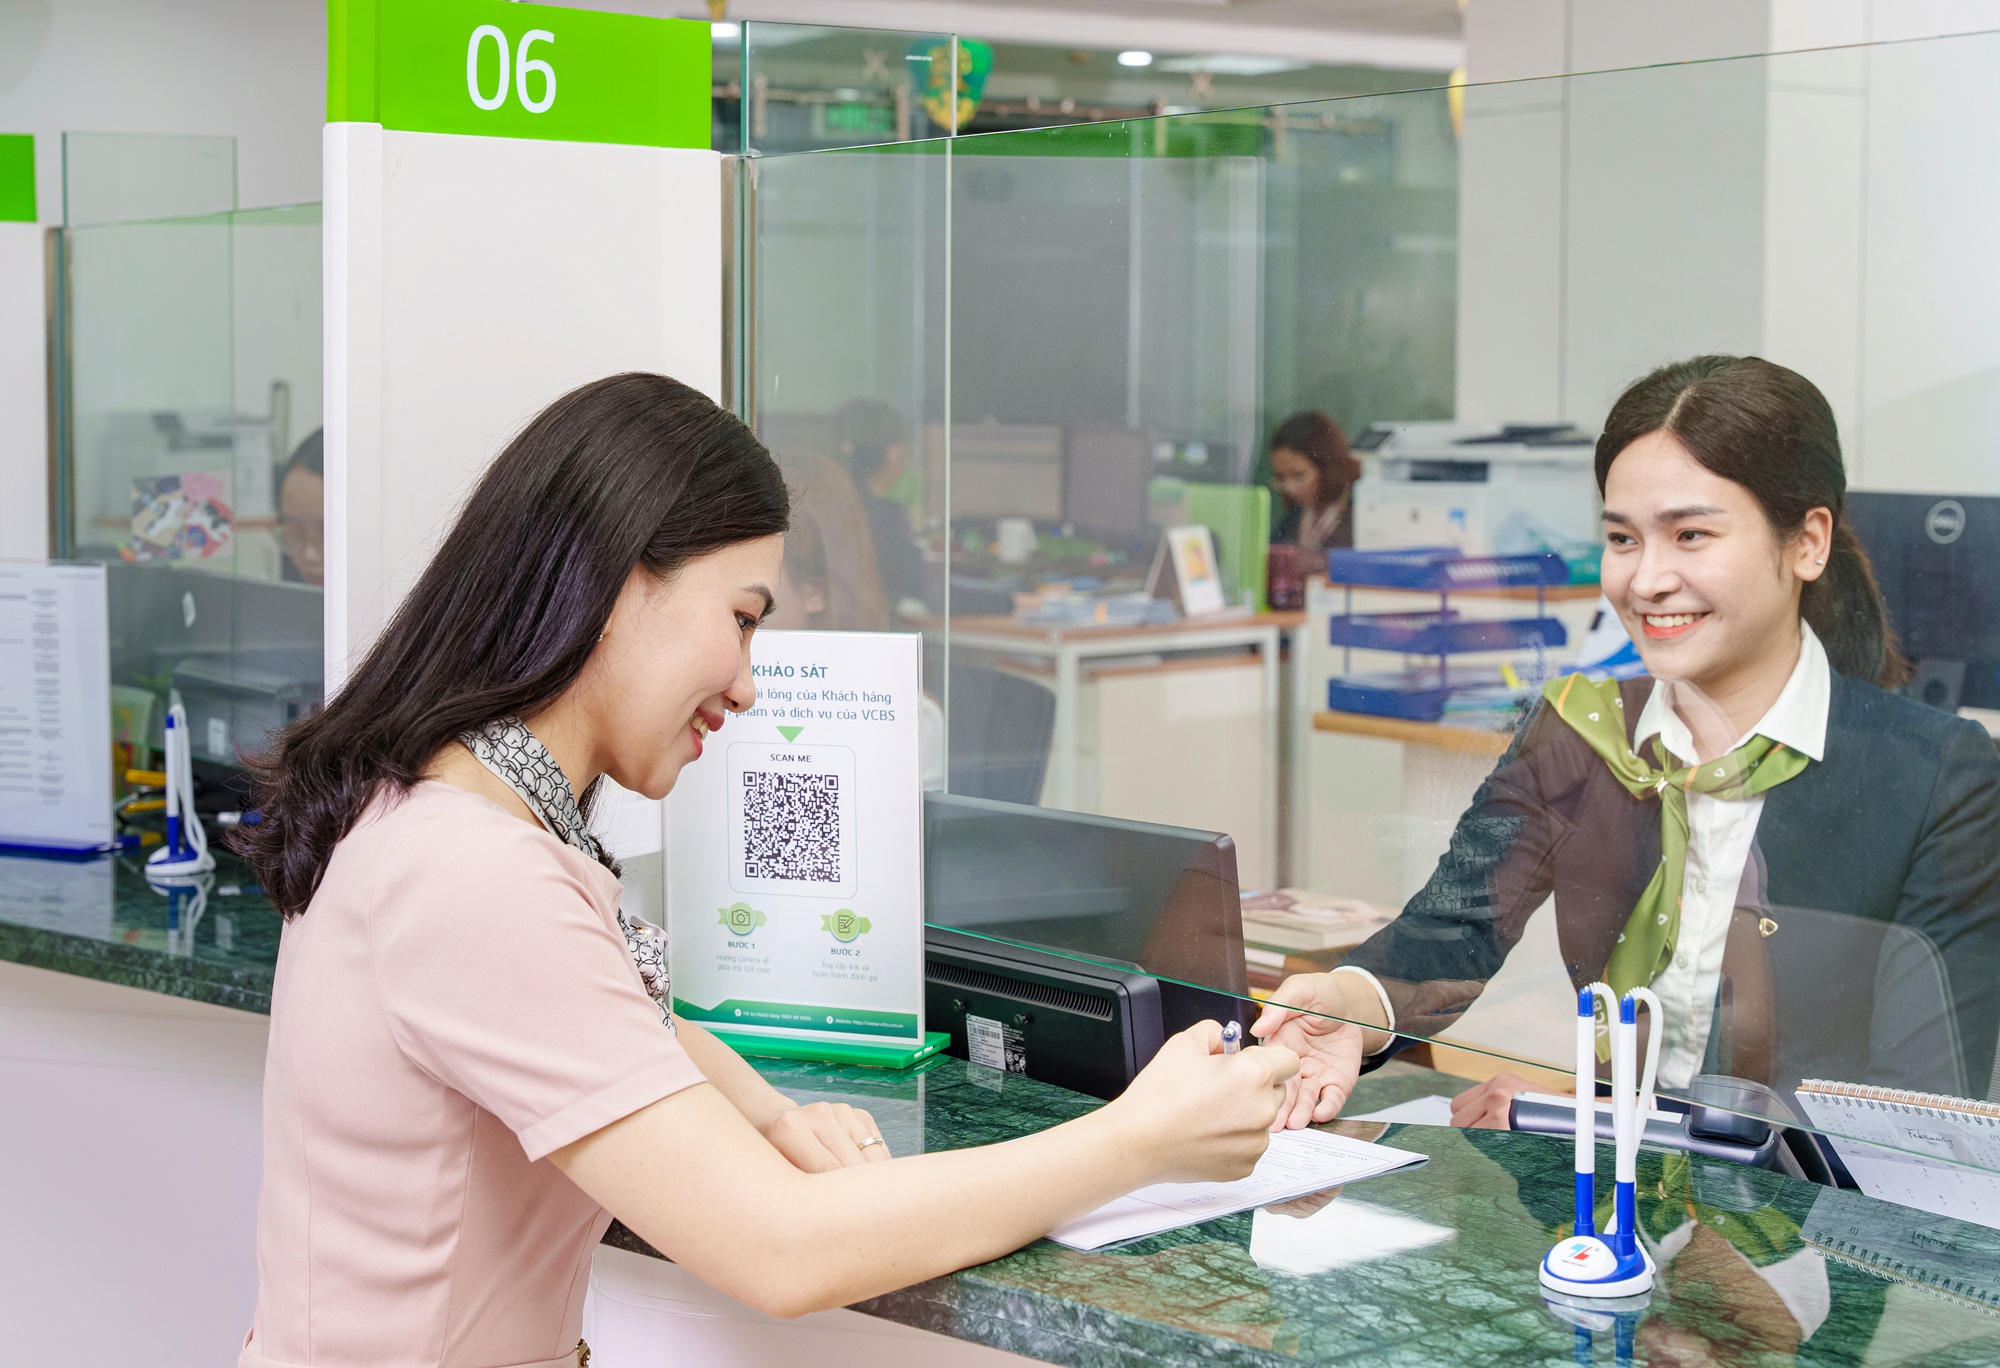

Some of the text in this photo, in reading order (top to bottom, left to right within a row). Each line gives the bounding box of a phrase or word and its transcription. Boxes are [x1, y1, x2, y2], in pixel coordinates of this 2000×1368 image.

[466, 24, 557, 114] 06
[751, 661, 828, 678] KHẢO SÁT
[767, 687, 792, 702] lòng
[796, 689, 817, 701] của
[822, 690, 858, 702] Khách
[862, 691, 892, 705] hàng
[772, 706, 786, 718] và
[790, 707, 814, 720] dịch
[818, 710, 832, 721] vụ
[836, 709, 857, 720] của
[861, 709, 896, 721] VCBS
[770, 753, 812, 763] SCAN ME
[738, 956, 760, 964] camera
[855, 949, 861, 957] 2
[743, 965, 755, 973] QR
[756, 966, 771, 974] code
[848, 962, 860, 970] link
[1593, 994, 1609, 1038] VCB
[1905, 1127, 1954, 1149] February
